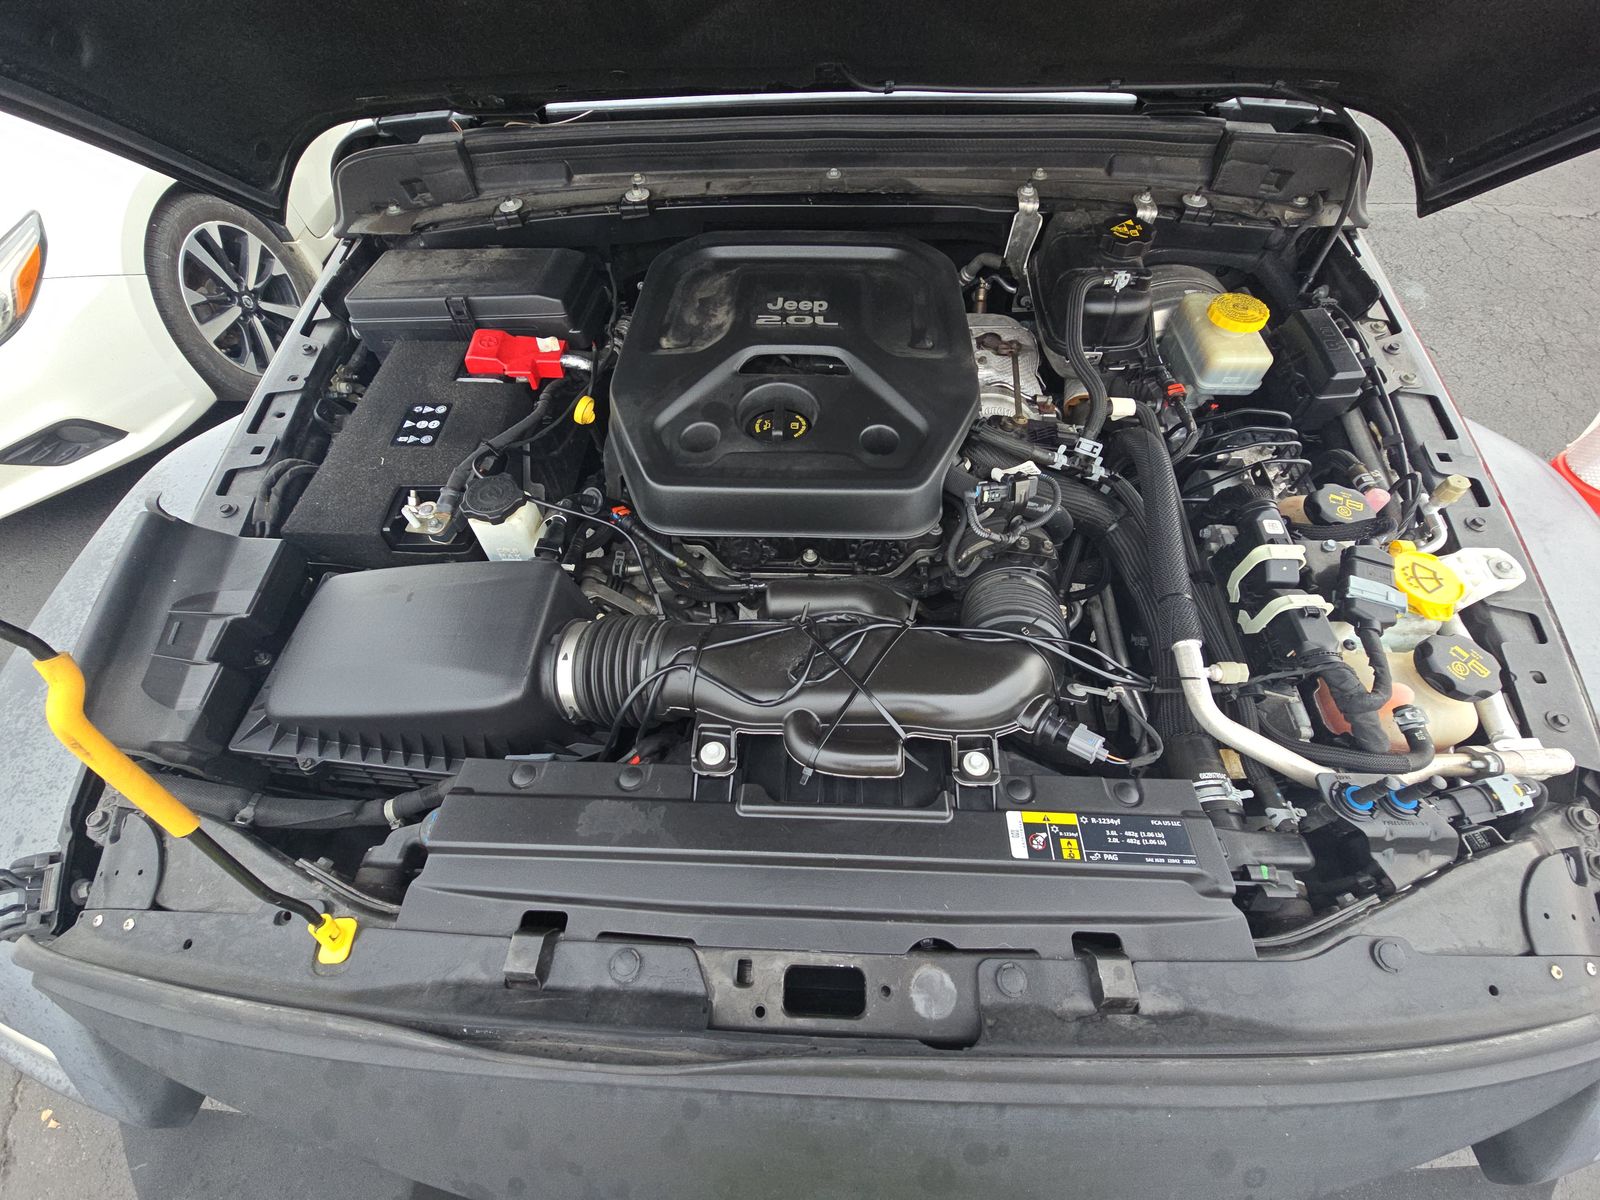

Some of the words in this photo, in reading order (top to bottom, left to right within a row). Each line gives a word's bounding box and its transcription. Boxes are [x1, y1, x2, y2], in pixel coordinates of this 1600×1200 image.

[767, 297, 828, 313] Jeep
[756, 315, 839, 326] 2.0L
[1091, 818, 1120, 826] R-1234yf
[1124, 830, 1138, 838] 482g
[1103, 853, 1119, 861] PAG
